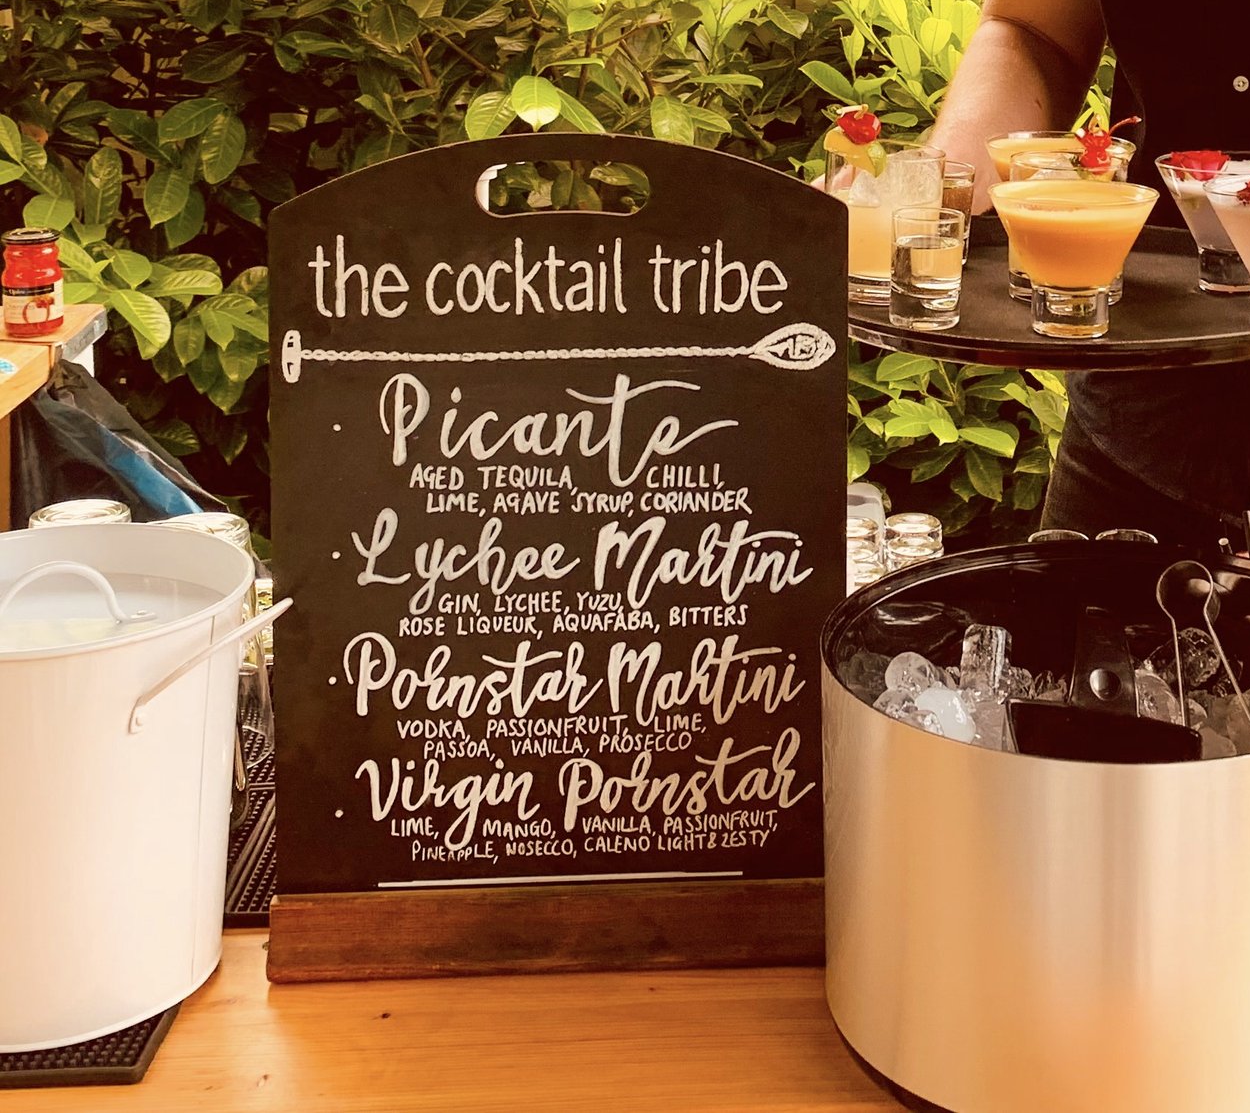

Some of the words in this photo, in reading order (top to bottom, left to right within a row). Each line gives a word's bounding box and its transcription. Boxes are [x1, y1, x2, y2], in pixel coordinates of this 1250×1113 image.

[307, 234, 411, 319] the
[424, 236, 628, 316] cocktail
[647, 238, 789, 316] tribe
[378, 372, 740, 487] Picante
[408, 462, 466, 491] AGED
[477, 463, 579, 497] TEQUILA,
[645, 463, 726, 493] CHILLI,
[425, 492, 487, 517] LIME,
[493, 492, 560, 516] AGAVE
[570, 491, 635, 518] SYRUP,
[640, 488, 753, 515] CORIANDER
[351, 507, 582, 615] Lychee
[595, 516, 816, 610] Martini
[437, 592, 482, 617] GIN,
[494, 590, 571, 617] LYCHEE,
[576, 591, 625, 614] YUZU,
[398, 615, 446, 638] ROSE
[457, 614, 544, 640] LIQUEUR,
[552, 611, 661, 635] AQUAFABA,
[668, 604, 750, 628] BITTERS
[342, 630, 604, 716] Pornstar
[606, 633, 807, 726] Martini
[397, 718, 472, 742] VODKA,
[485, 715, 630, 740] PASSIONFRUIT,
[653, 713, 707, 735] LIME,
[423, 736, 499, 762] PASSOA,
[511, 736, 591, 758] VANILLA,
[599, 730, 692, 754] PROSECCO
[354, 757, 542, 851] Virgin
[558, 727, 817, 832] Pornstar
[391, 818, 440, 842] LIME,
[482, 817, 557, 840] MANGO,
[582, 816, 658, 837] VANILLA,
[663, 809, 780, 837] PASSIONFRUIT,
[505, 839, 579, 860] NOSECCO,
[584, 834, 651, 855] CALENO
